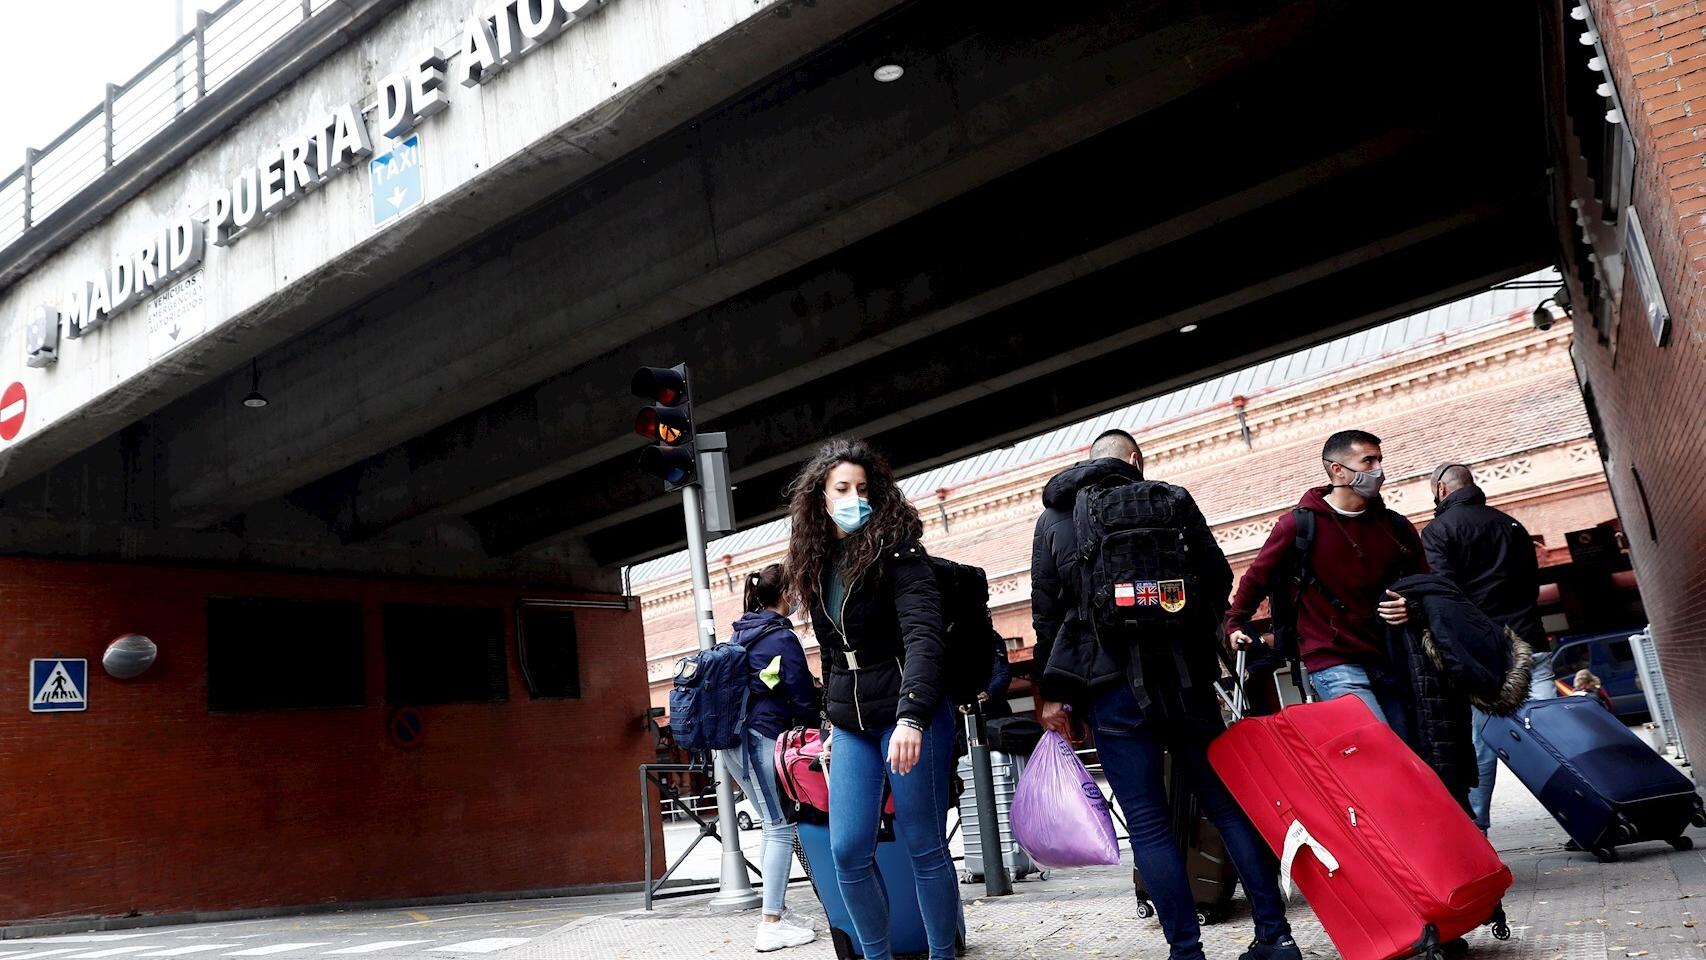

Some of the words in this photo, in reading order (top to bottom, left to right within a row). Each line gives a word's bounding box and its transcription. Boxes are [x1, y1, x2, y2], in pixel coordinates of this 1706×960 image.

[60, 215, 197, 337] MADRID
[208, 102, 366, 245] PUERTA
[377, 47, 443, 137] DE
[460, 0, 595, 85] ATO
[374, 145, 417, 186] TAXI
